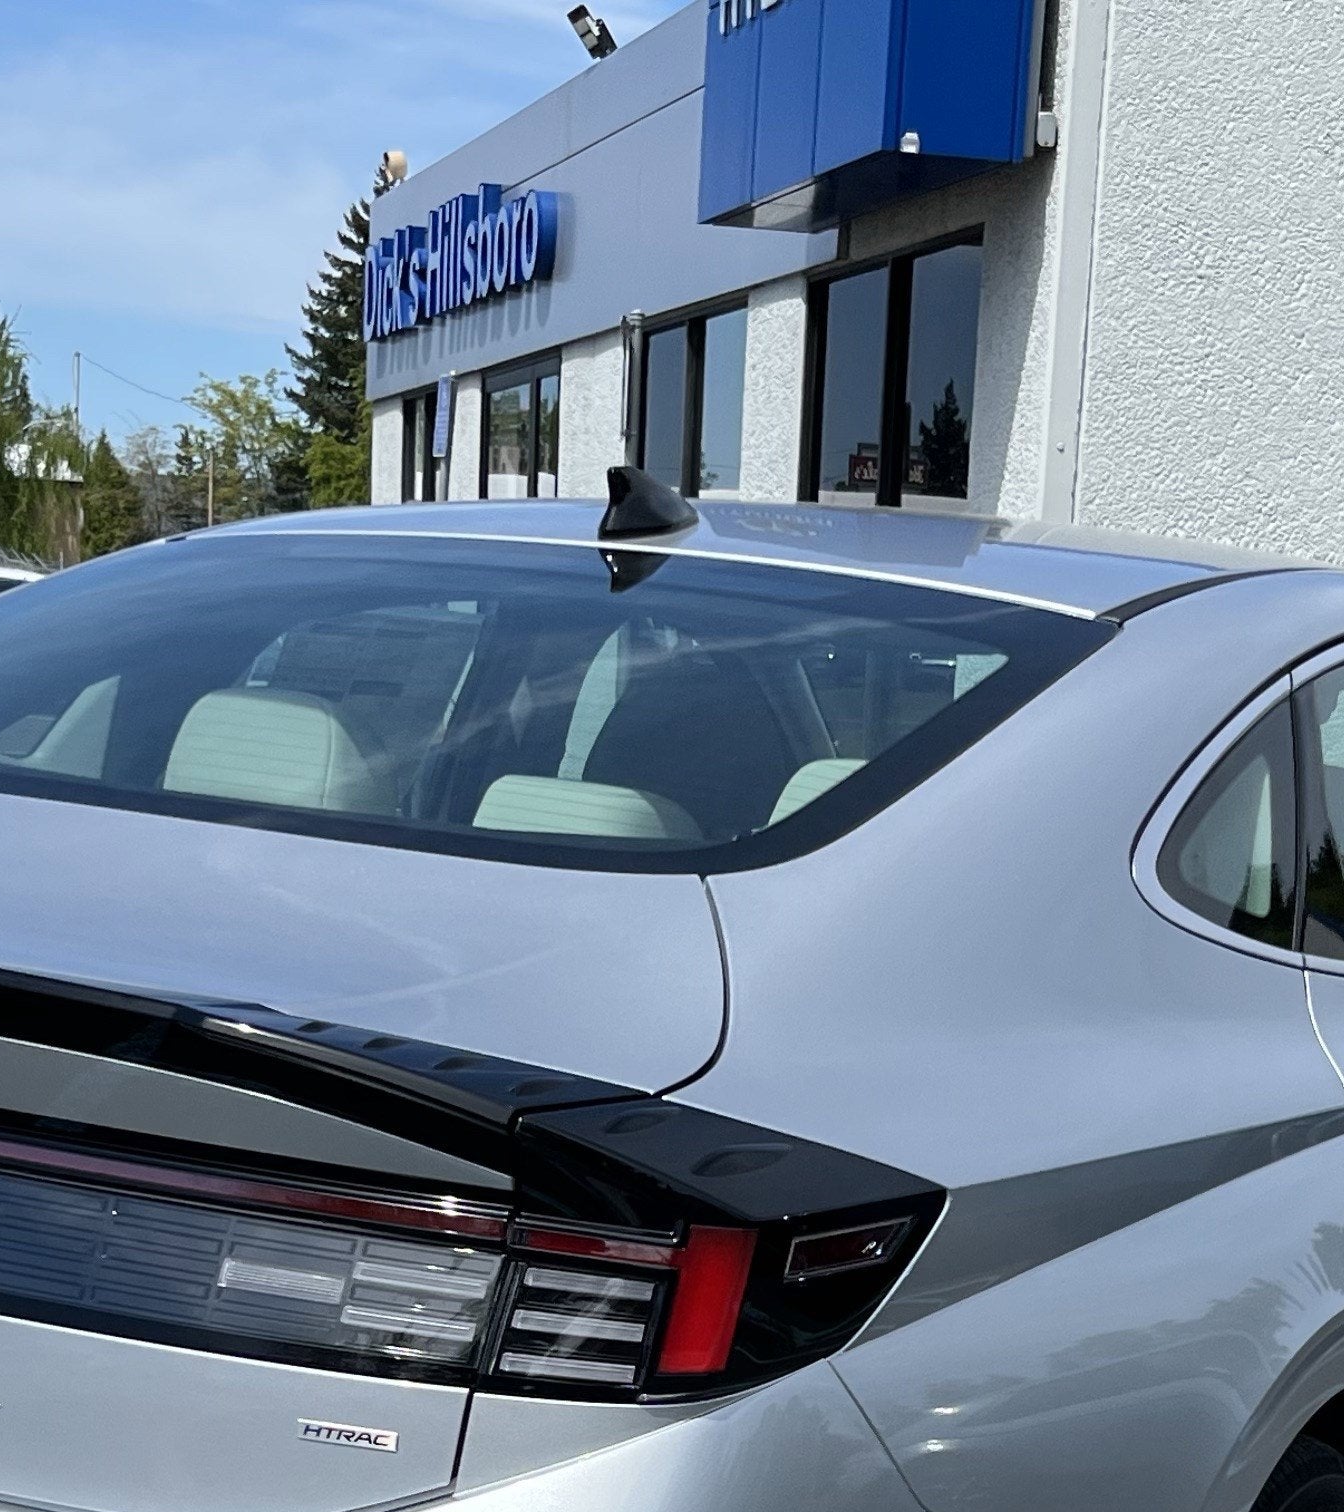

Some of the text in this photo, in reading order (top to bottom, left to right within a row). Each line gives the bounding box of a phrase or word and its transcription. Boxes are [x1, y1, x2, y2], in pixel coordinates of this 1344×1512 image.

[363, 183, 542, 342] Dick's Hillsboro
[302, 1424, 391, 1447] HTRAC
